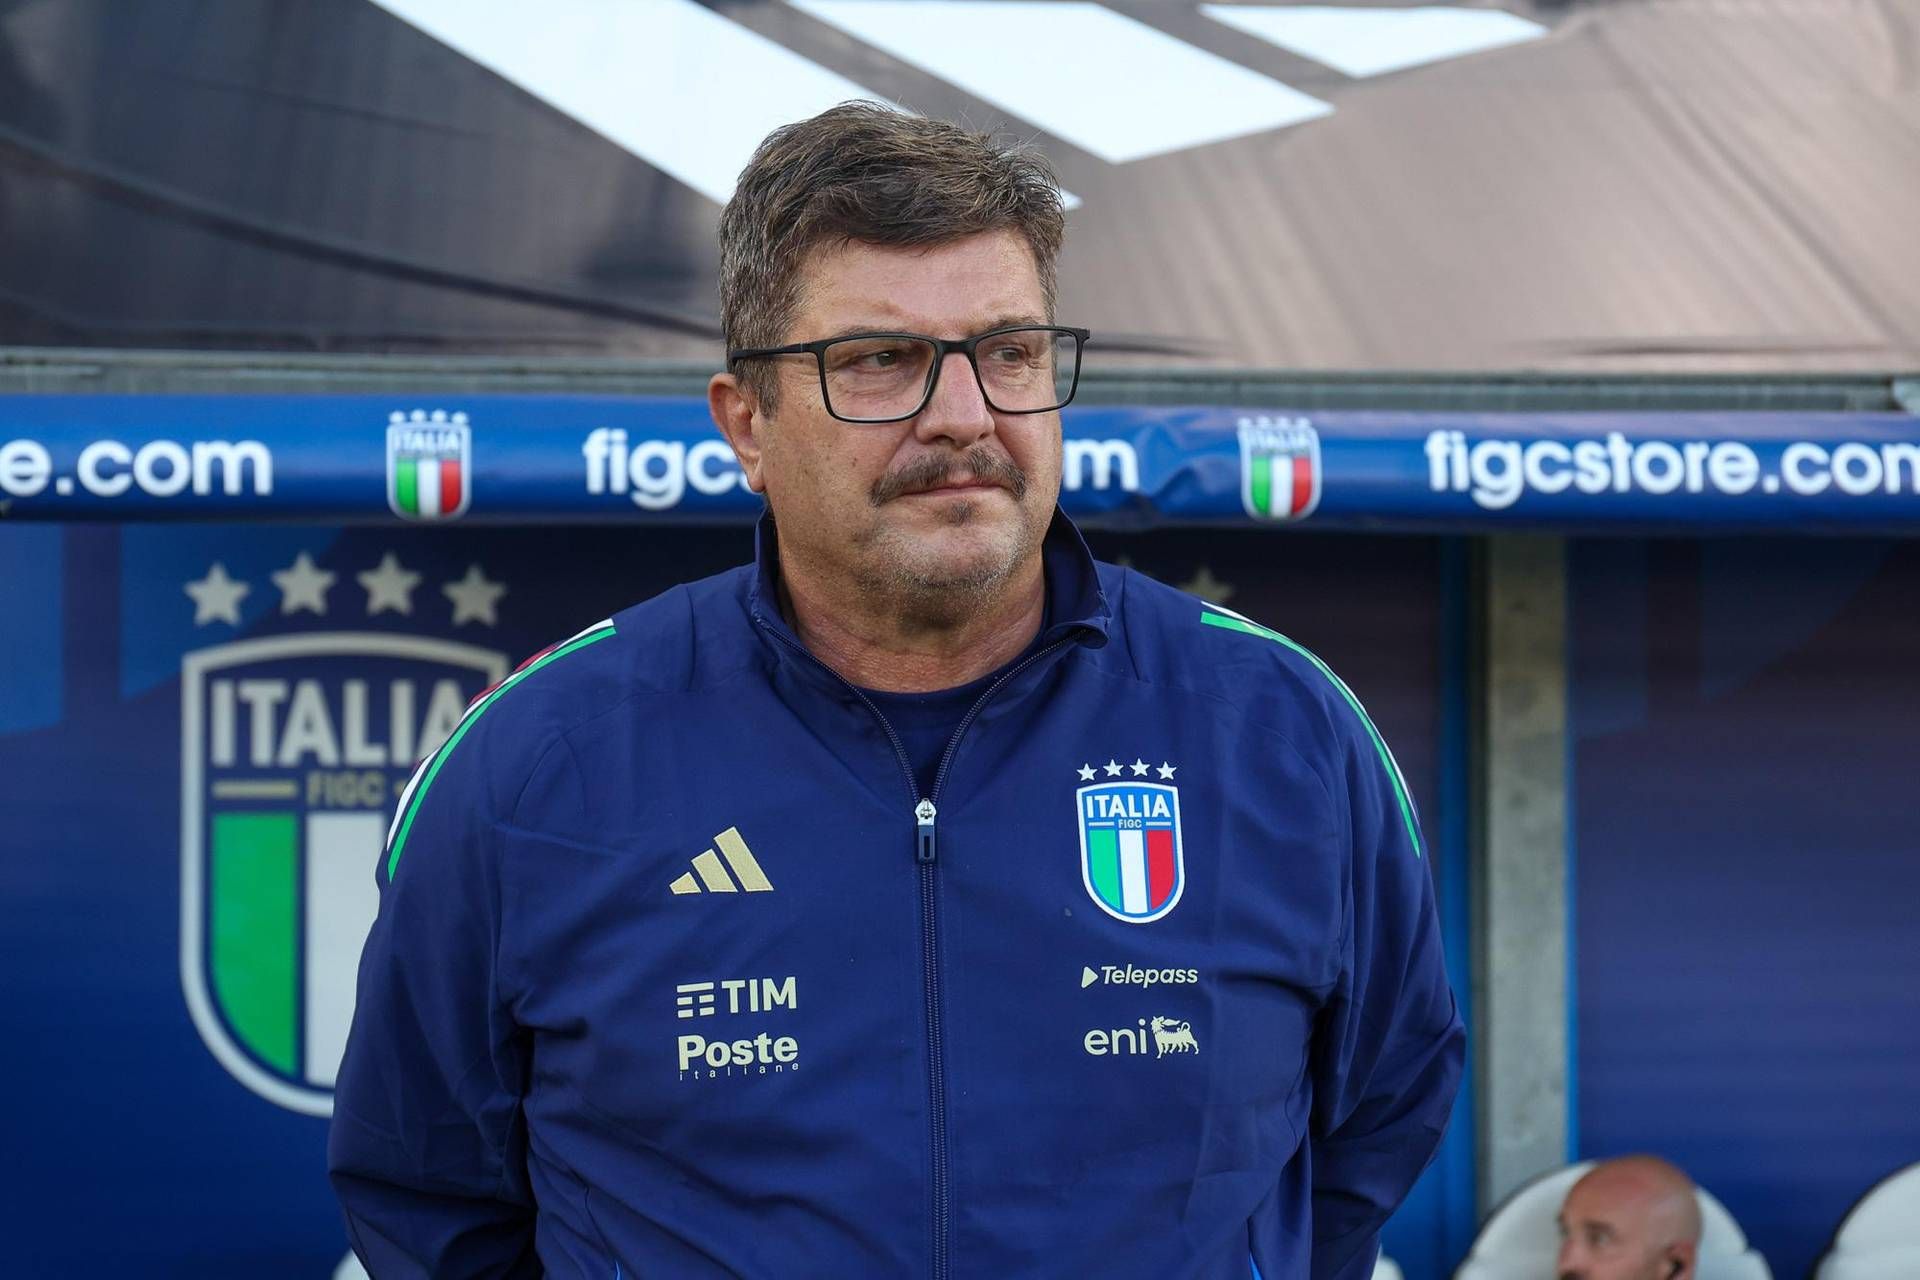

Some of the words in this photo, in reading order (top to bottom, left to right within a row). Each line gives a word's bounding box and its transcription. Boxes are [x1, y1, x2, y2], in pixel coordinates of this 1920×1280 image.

[582, 427, 763, 511] figc
[211, 679, 467, 767] ITALIA
[1086, 794, 1172, 818] ITALIA
[1118, 819, 1142, 829] FIGC
[1101, 963, 1199, 989] Telepass
[721, 976, 797, 1014] TIM
[678, 1032, 799, 1071] Poste
[1084, 1018, 1147, 1055] eni
[679, 1062, 799, 1081] italiane
